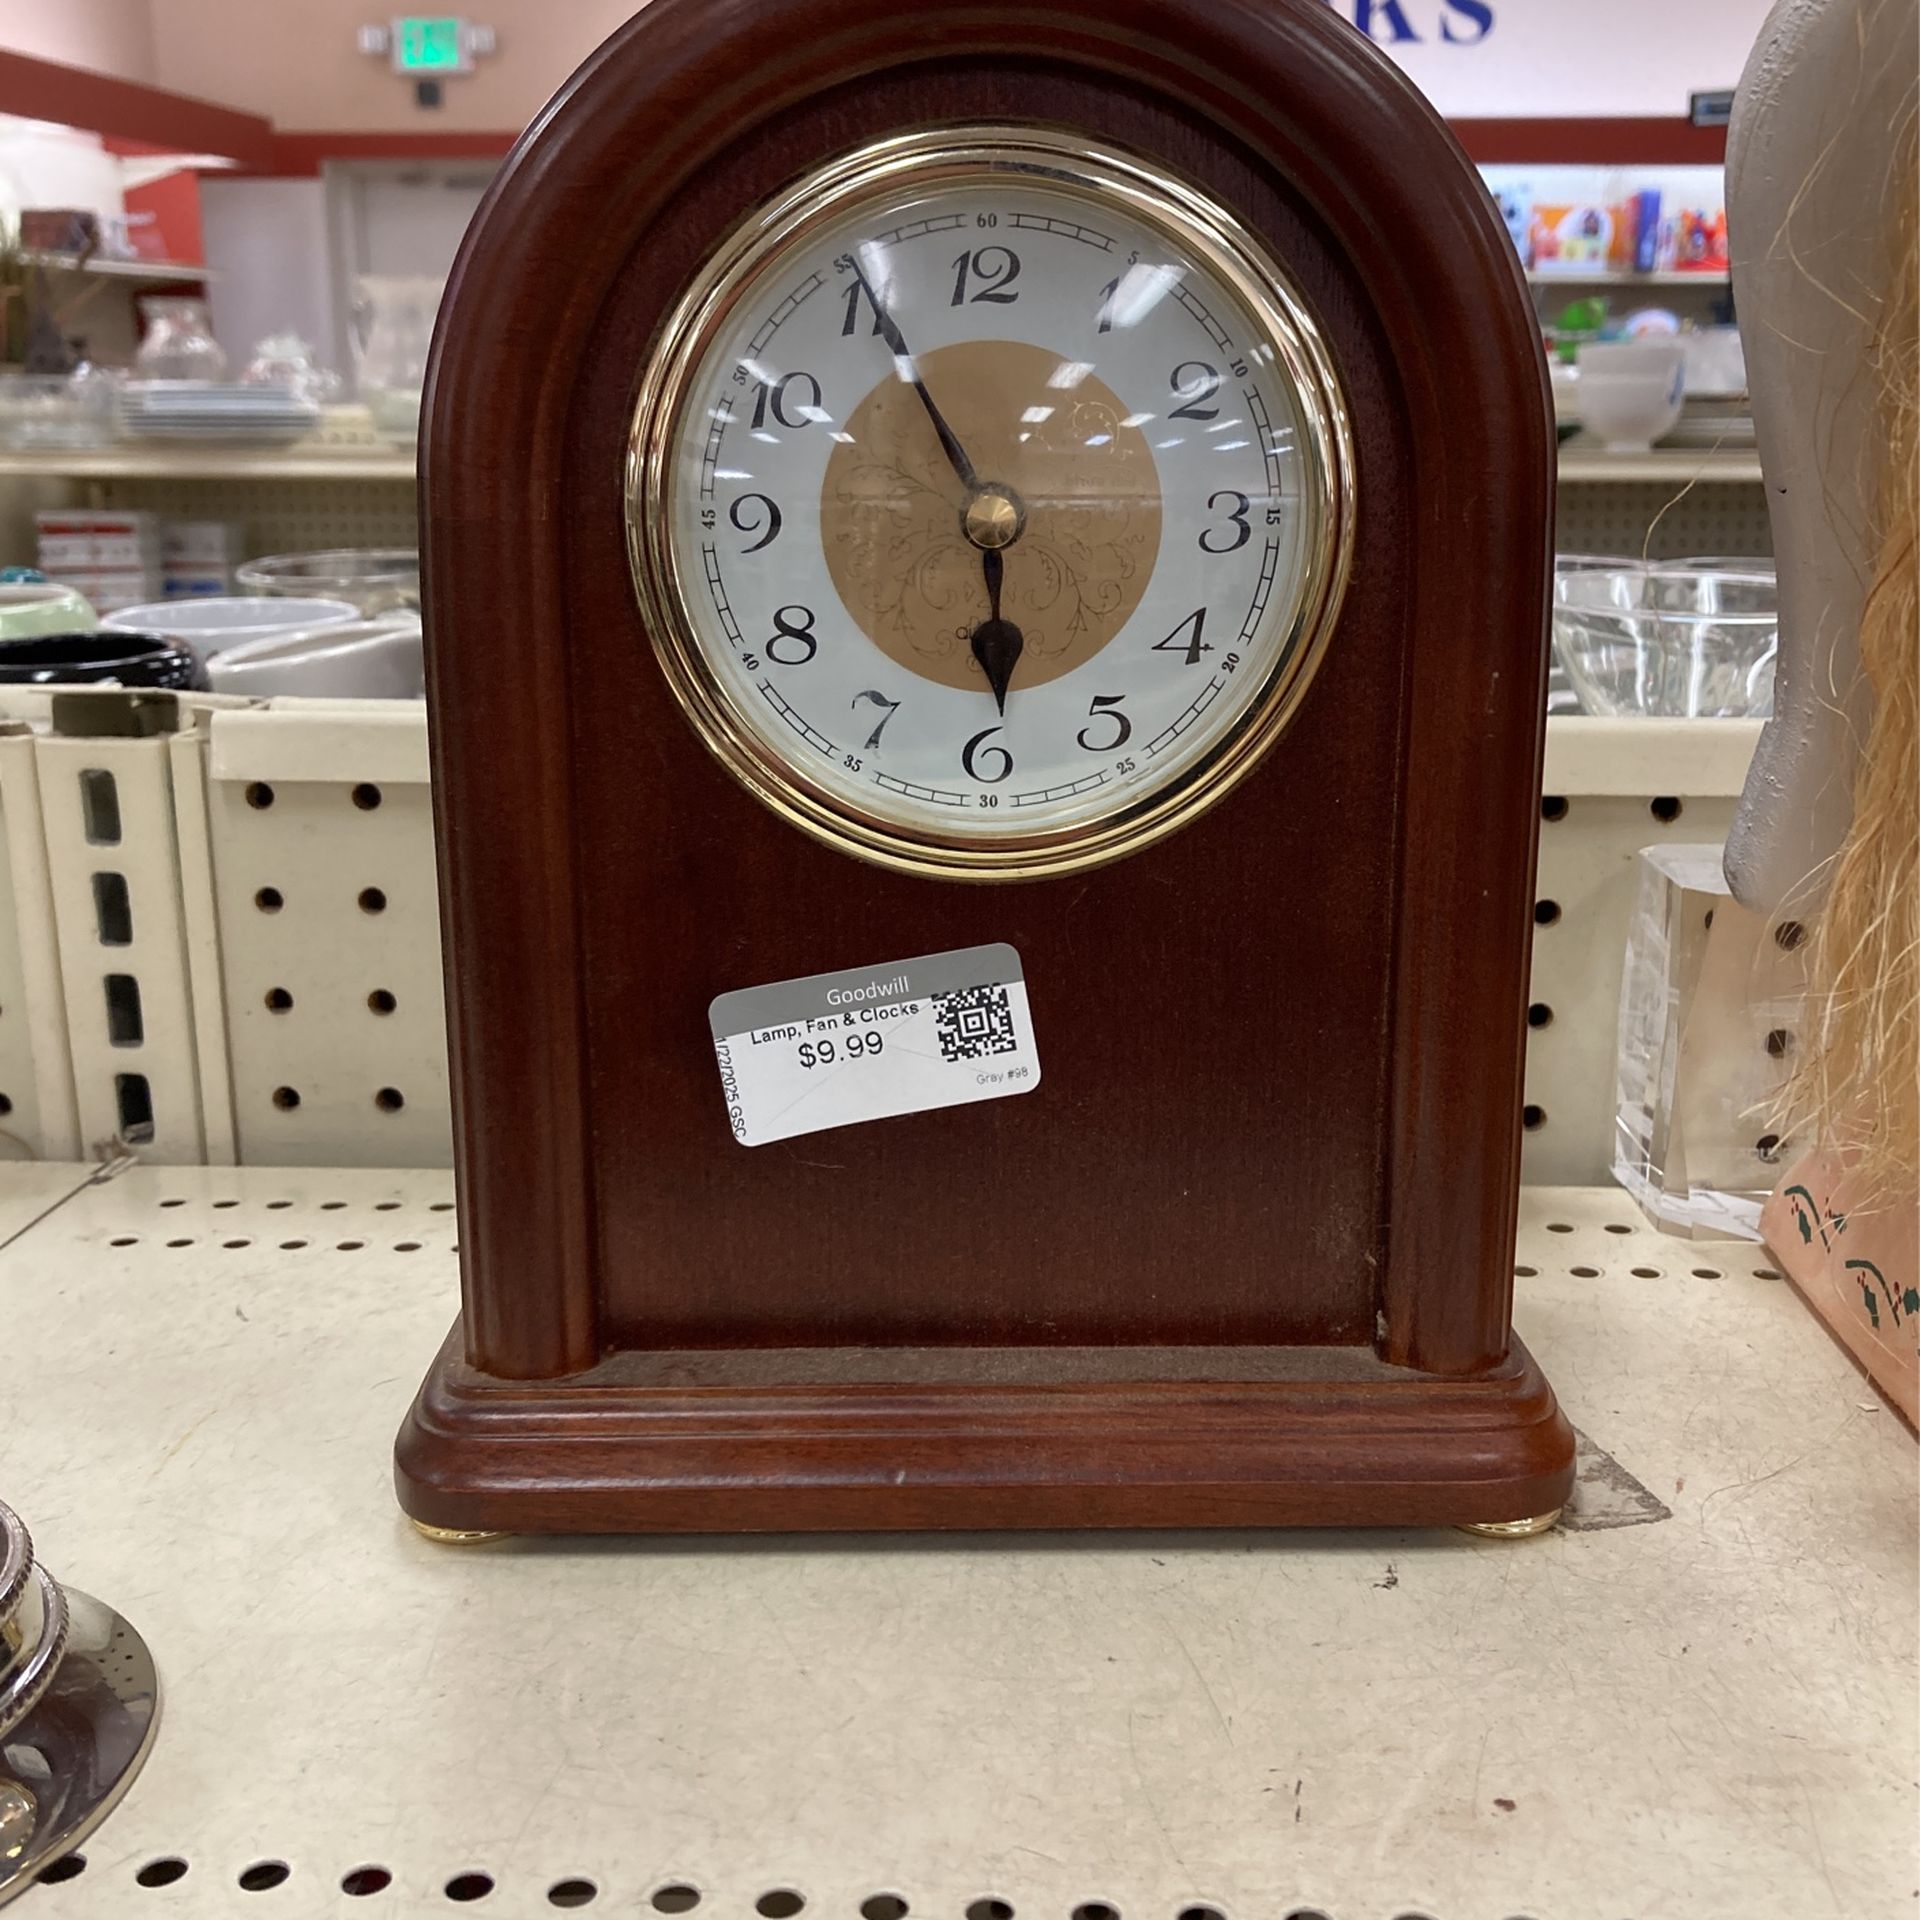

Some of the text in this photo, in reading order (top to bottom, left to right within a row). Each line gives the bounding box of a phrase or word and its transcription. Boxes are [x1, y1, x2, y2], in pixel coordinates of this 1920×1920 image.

[977, 212, 997, 228] 60
[952, 246, 1020, 307] 12
[1230, 357, 1249, 378] 10
[751, 371, 822, 429] 10
[1168, 361, 1221, 421] 2
[701, 509, 716, 530] 45
[729, 493, 782, 554] 9
[1198, 490, 1251, 553] 3
[1266, 507, 1280, 525] 15
[765, 605, 817, 665] 8
[1151, 607, 1215, 666] 4
[742, 651, 760, 671] 40
[1221, 652, 1240, 674] 20
[851, 690, 901, 750] 7
[1076, 695, 1132, 752] 5
[843, 754, 863, 772] 35
[962, 726, 1014, 784] 6
[1116, 757, 1136, 776] 25
[979, 794, 998, 808] 30
[826, 975, 910, 1006] Goodwill
[750, 1001, 920, 1046] Lamp, Fan & Clocks
[798, 1030, 884, 1070] $9.99
[976, 1066, 1029, 1085] Gray #98
[729, 1105, 747, 1138] GSC
